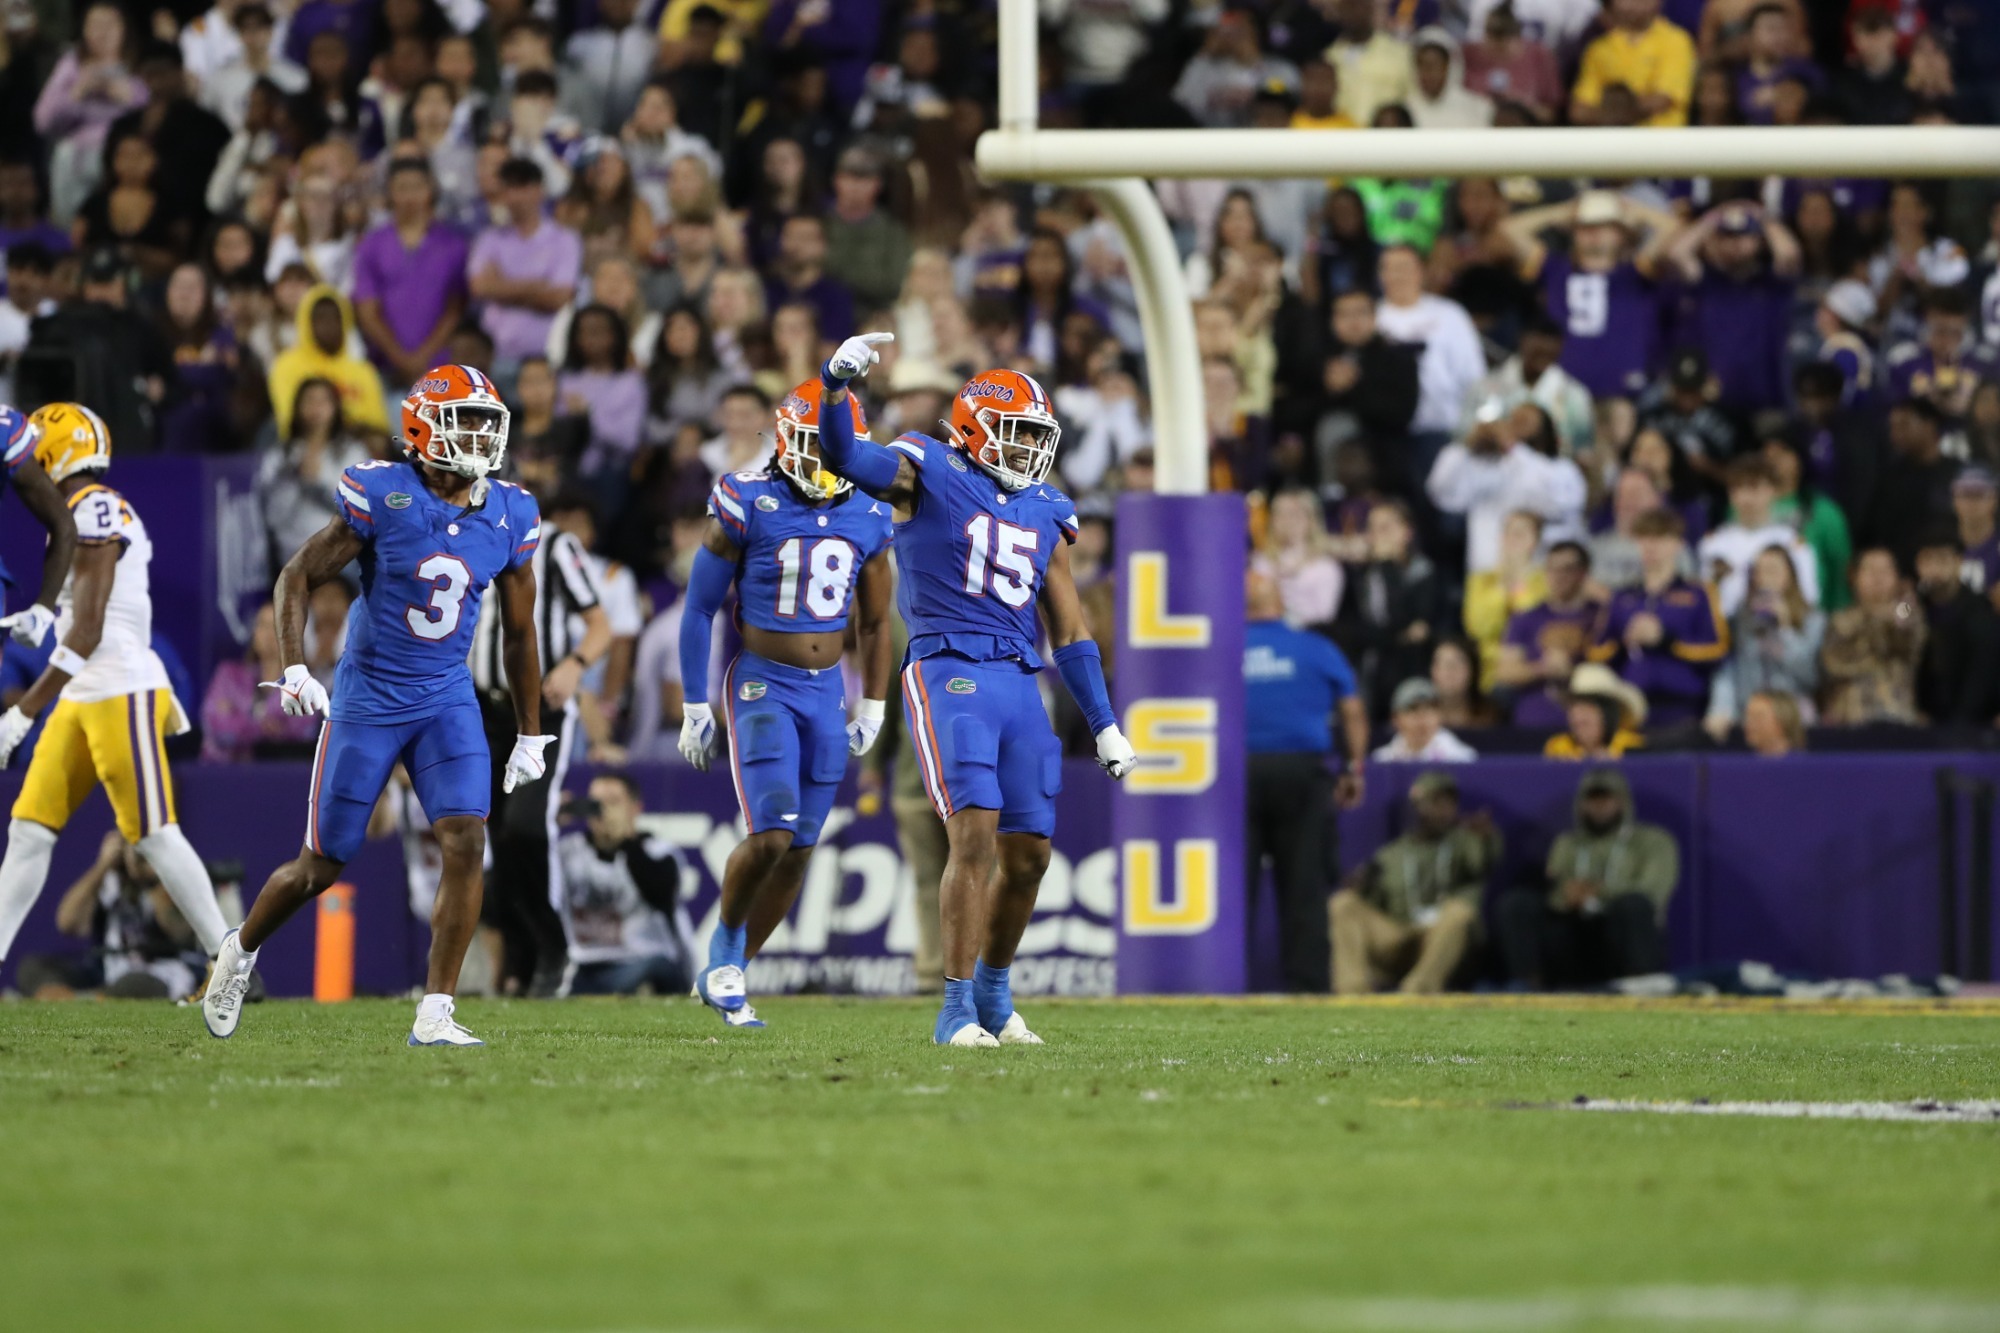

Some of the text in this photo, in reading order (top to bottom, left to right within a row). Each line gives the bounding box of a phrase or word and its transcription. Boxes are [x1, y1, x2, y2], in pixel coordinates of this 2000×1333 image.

[961, 380, 1014, 402] Gators
[94, 501, 111, 528] 2
[405, 552, 473, 642] 3
[774, 537, 857, 621] 18
[965, 512, 1039, 610] 15
[1123, 552, 1217, 935] LSU
